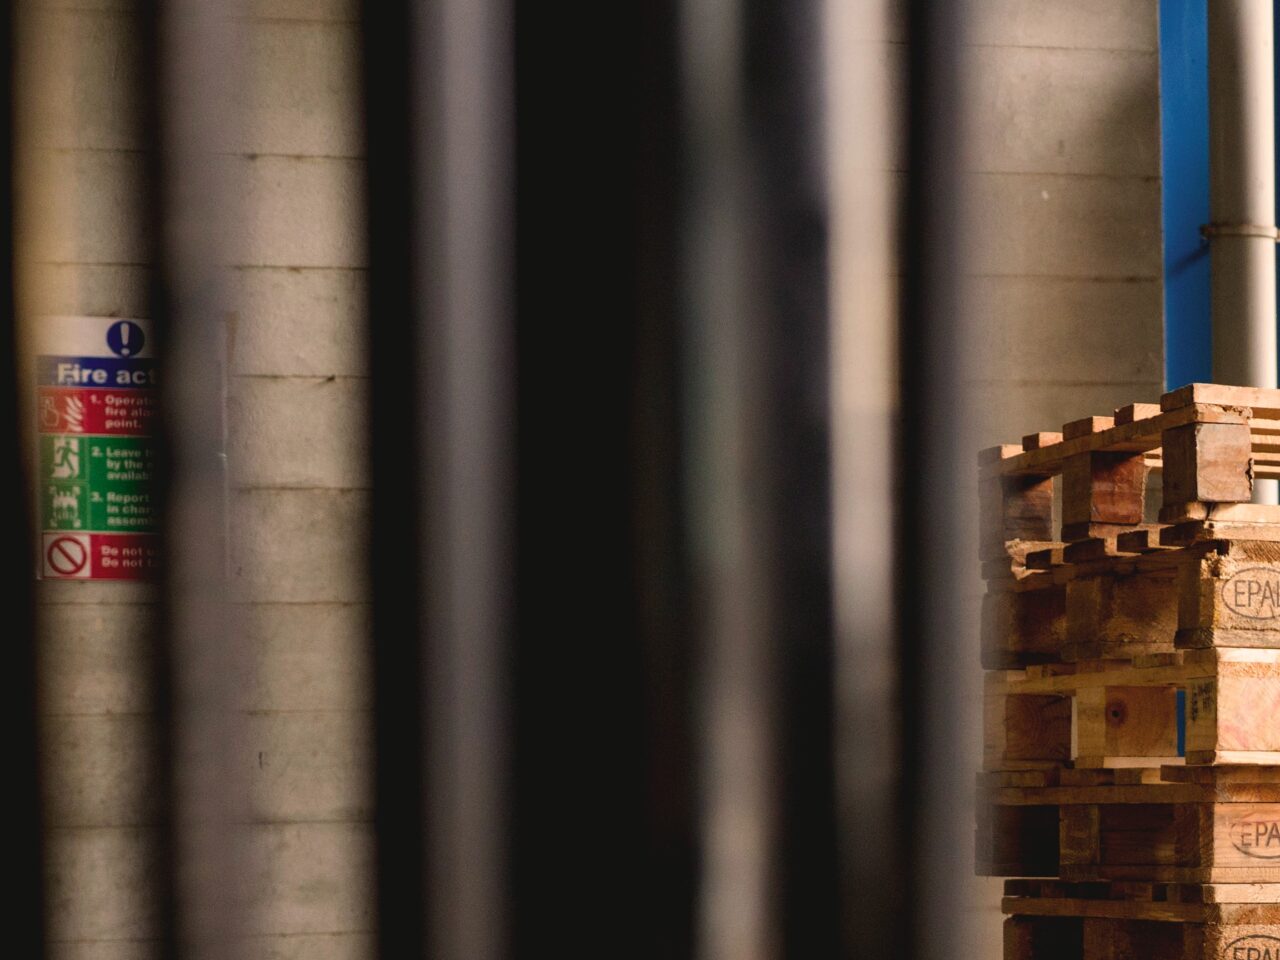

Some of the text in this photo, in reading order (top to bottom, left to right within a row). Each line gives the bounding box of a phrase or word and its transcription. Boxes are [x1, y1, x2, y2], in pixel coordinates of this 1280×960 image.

[57, 363, 108, 384] Fire
[105, 394, 153, 406] Operat
[105, 406, 127, 416] fire
[91, 446, 103, 457] 2.
[106, 447, 142, 457] Leave
[106, 459, 120, 470] by
[124, 459, 143, 469] the
[90, 491, 150, 504] 3. Report
[106, 505, 154, 514] in char
[101, 545, 119, 556] Do
[122, 547, 143, 556] not
[101, 557, 119, 568] Do
[122, 559, 143, 567] not
